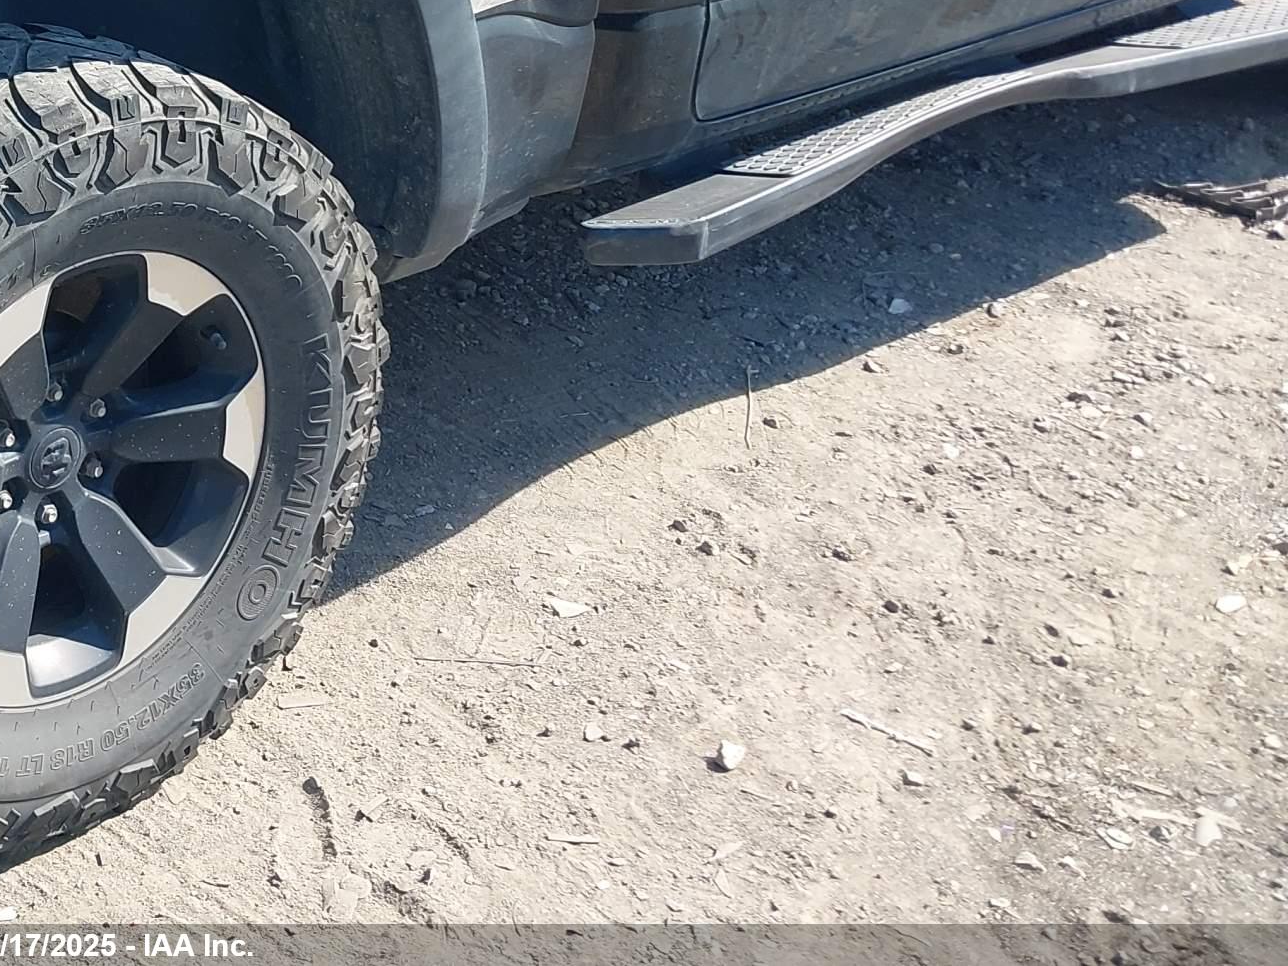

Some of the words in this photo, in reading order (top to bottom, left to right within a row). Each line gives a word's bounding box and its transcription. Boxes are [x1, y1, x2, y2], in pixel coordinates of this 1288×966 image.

[236, 332, 333, 621] KUMHO
[100, 662, 205, 752] 35X12.50
[15, 752, 45, 778] LT
